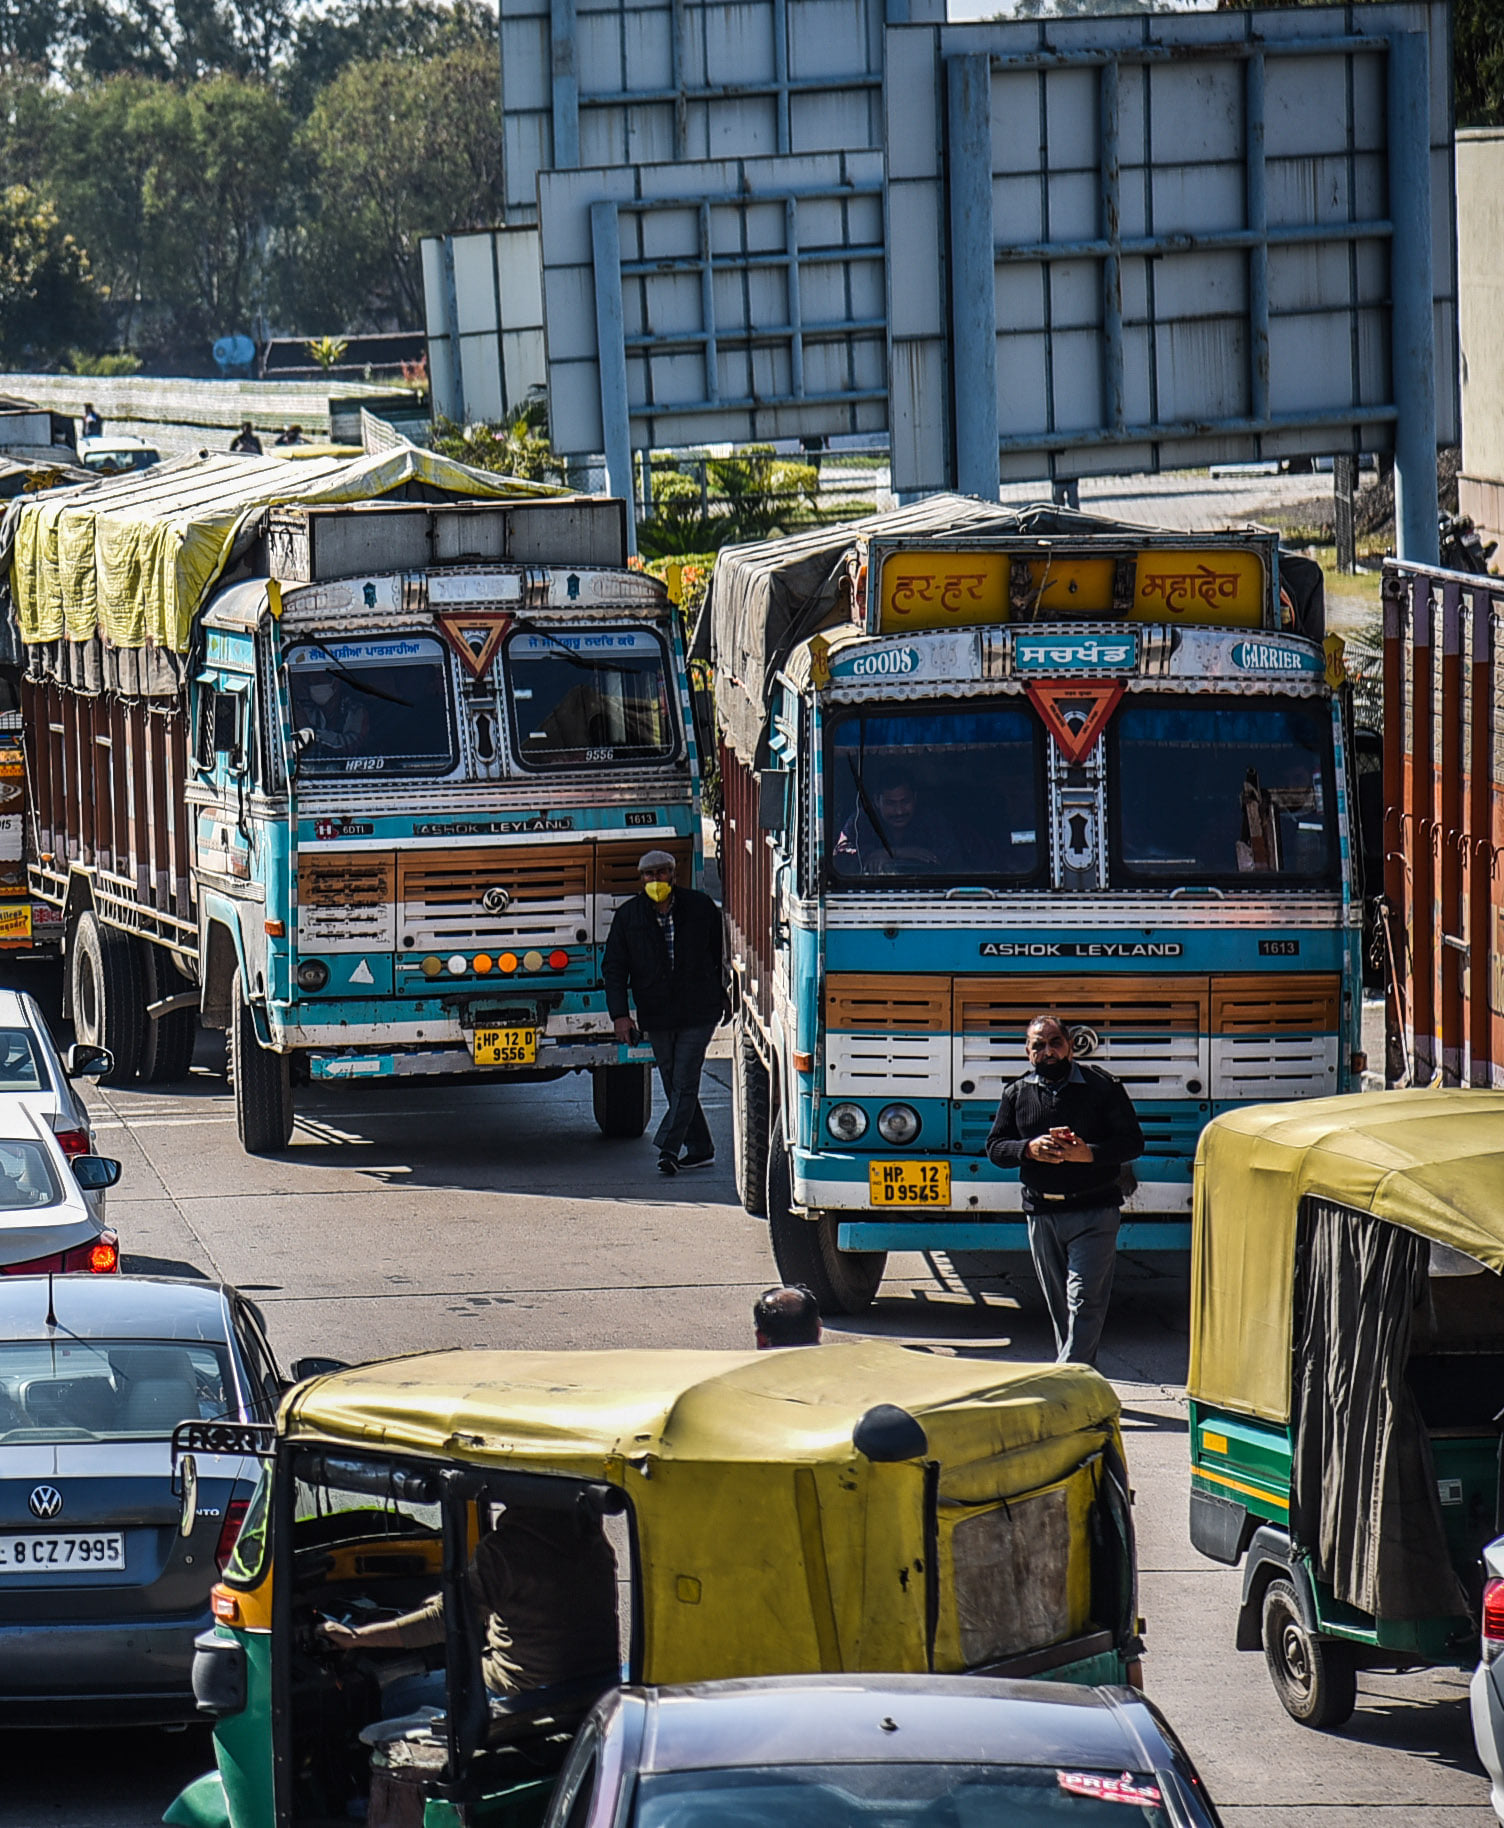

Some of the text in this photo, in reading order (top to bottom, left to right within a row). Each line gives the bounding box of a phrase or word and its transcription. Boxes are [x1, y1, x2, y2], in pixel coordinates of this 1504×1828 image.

[892, 564, 1242, 614] हर-हर महादेव
[853, 647, 912, 675] GOODS
[1242, 641, 1302, 670] CARRIER
[585, 750, 614, 761] 9556
[420, 820, 571, 835] ASHOK LEYLAND
[628, 814, 653, 825] 1613
[983, 943, 1181, 956] ASHOK LEYLAND
[1263, 942, 1295, 954] 1613
[484, 1033, 499, 1047] HP
[505, 1032, 519, 1046] 12
[525, 1031, 533, 1045] D
[493, 1047, 525, 1061] 9556
[920, 1166, 939, 1183] 12
[15, 1542, 27, 1563] 8
[64, 1538, 121, 1562] 7995
[1065, 1774, 1155, 1797] PRESS
